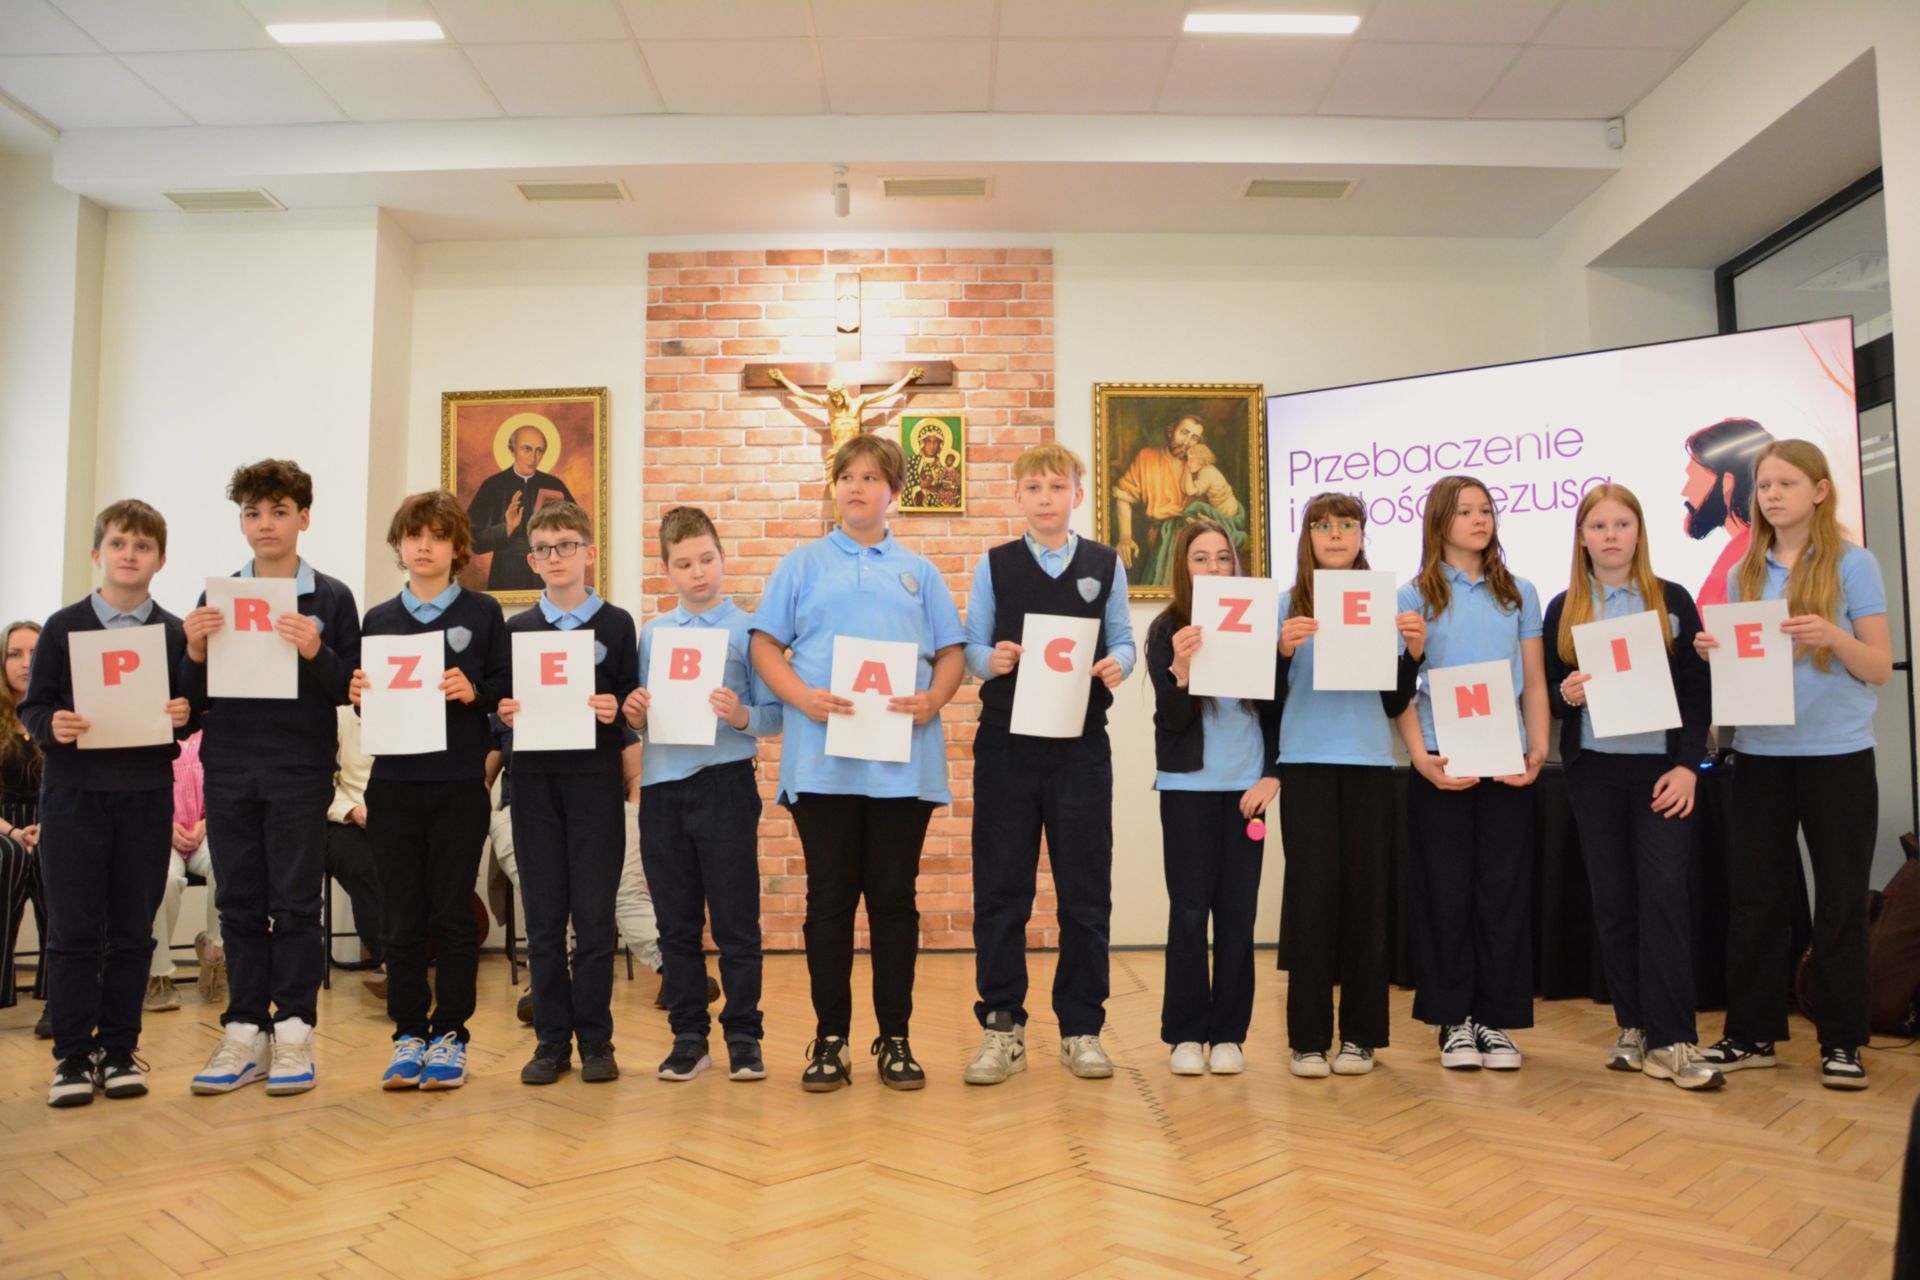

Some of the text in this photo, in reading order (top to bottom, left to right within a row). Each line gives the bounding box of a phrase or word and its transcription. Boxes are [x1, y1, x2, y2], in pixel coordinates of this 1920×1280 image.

[1288, 423, 1585, 487] Przebaczenie
[1289, 497, 1296, 533] i
[233, 597, 274, 633] R
[1217, 597, 1253, 633] Z
[1343, 591, 1371, 626] E
[1043, 637, 1077, 673] C
[1610, 638, 1632, 673] I
[1733, 622, 1766, 659] E
[102, 649, 141, 687] P
[387, 655, 423, 689] Z
[540, 651, 568, 686] E
[669, 647, 702, 681] B
[852, 660, 893, 696] A
[1455, 683, 1492, 719] N
